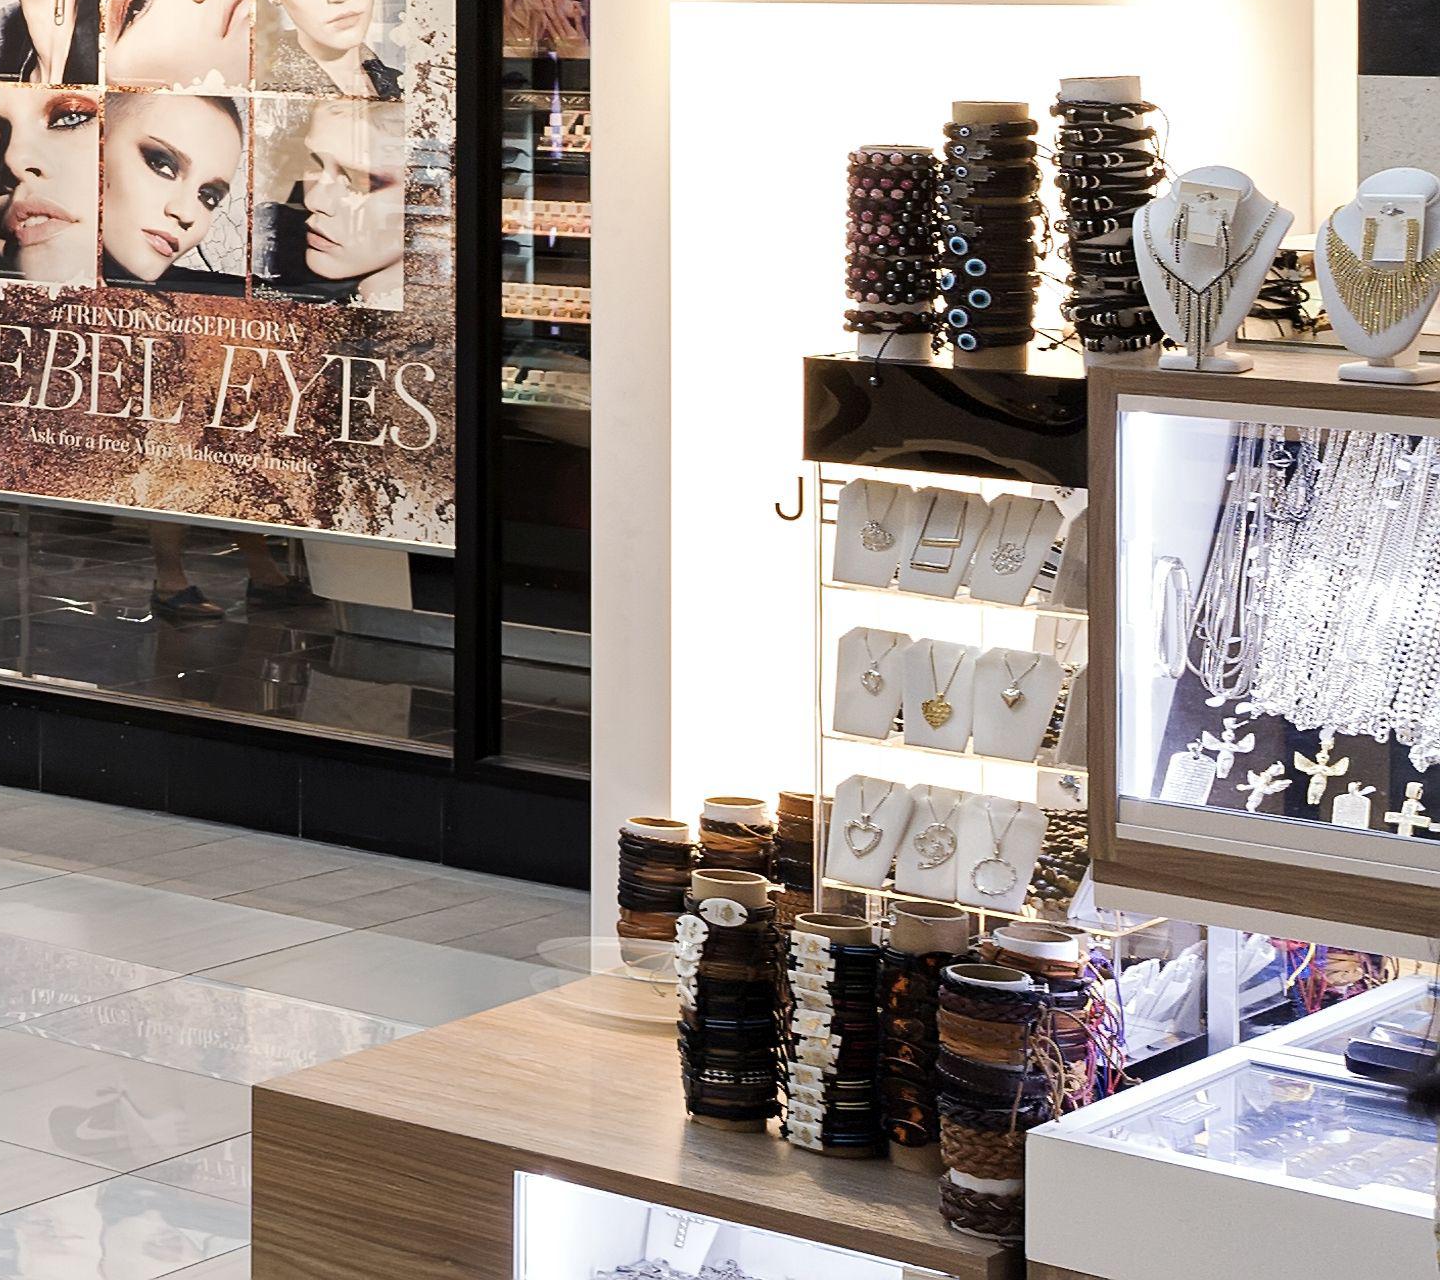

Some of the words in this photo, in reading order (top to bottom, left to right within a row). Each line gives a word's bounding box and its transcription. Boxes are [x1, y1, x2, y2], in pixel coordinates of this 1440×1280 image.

[50, 304, 299, 344] #TRENDINGatSEPHORA
[207, 343, 438, 453] EYES
[30, 425, 56, 446] Ask
[59, 427, 81, 447] for
[85, 436, 96, 450] a
[96, 433, 130, 454] free
[131, 438, 173, 459] Mini
[179, 443, 260, 470] Makeover
[263, 454, 318, 476] inside
